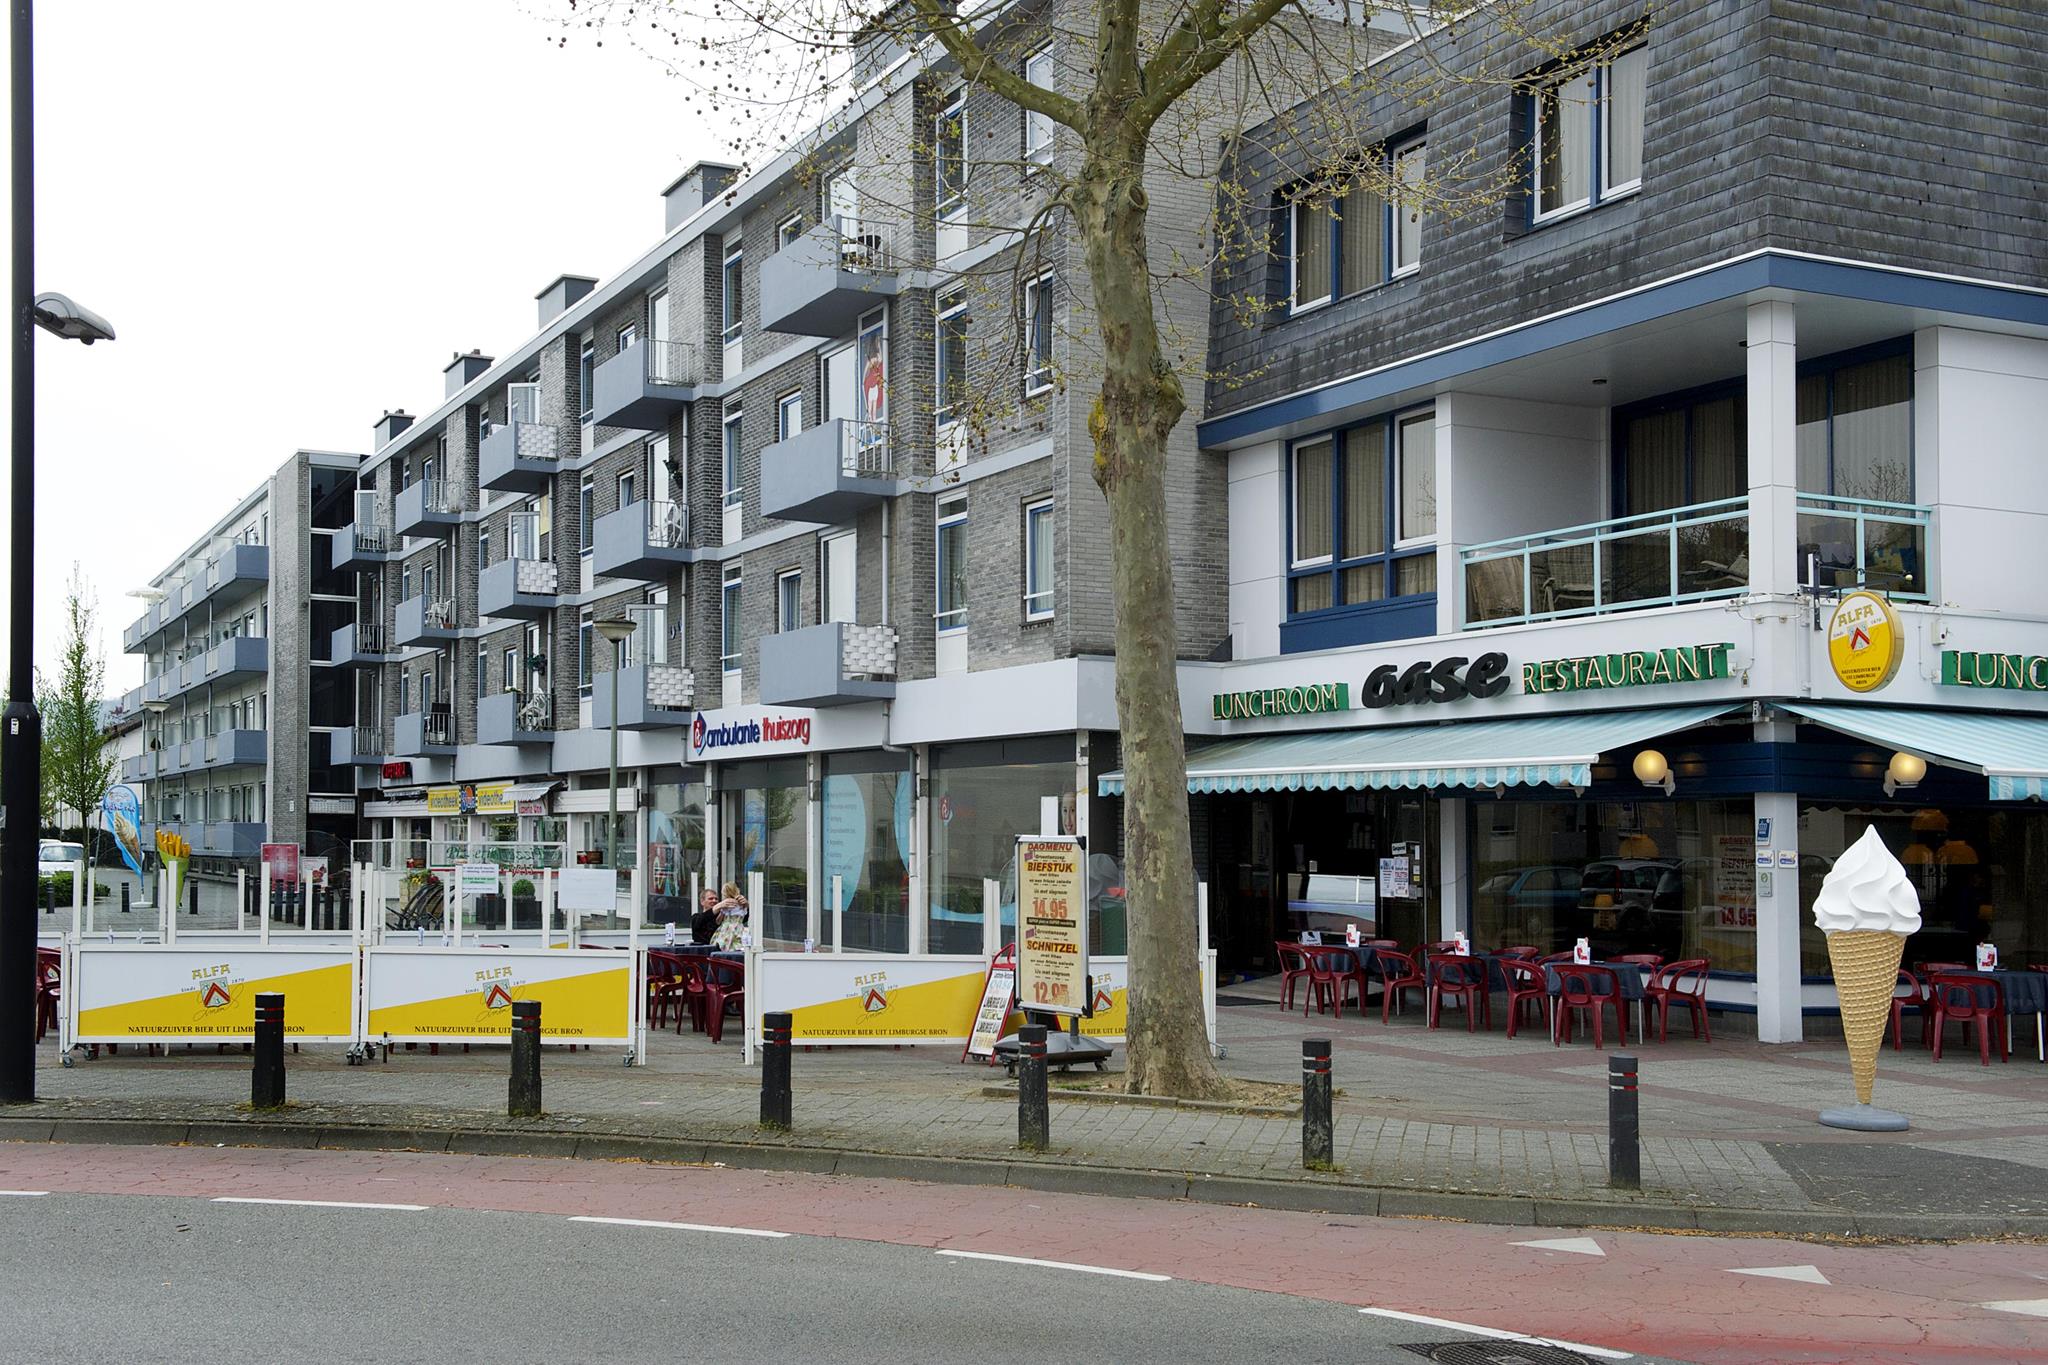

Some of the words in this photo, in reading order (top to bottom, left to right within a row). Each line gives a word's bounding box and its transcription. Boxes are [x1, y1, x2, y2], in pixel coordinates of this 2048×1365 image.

[1837, 604, 1874, 627] ALFA
[1212, 683, 1350, 721] LUNCHROOM
[1522, 642, 1736, 695] RESTAURANT
[707, 719, 760, 748] ambulante
[762, 715, 810, 745] thuiszorg
[1027, 862, 1073, 873] BIEFSTUK
[1032, 899, 1068, 919] 14.95
[1027, 940, 1078, 954] SCHNITZEL
[191, 963, 230, 980] ALFA
[475, 966, 513, 982] ALFA
[854, 971, 887, 986] ALFA
[478, 1026, 496, 1034] BIER
[560, 1027, 583, 1035] BRON
[802, 1028, 856, 1036] NATUURZUIVER
[857, 1028, 873, 1036] BIER
[875, 1028, 887, 1036] UIT
[888, 1028, 927, 1036] LIMBURGSE
[928, 1028, 948, 1036] BRON
